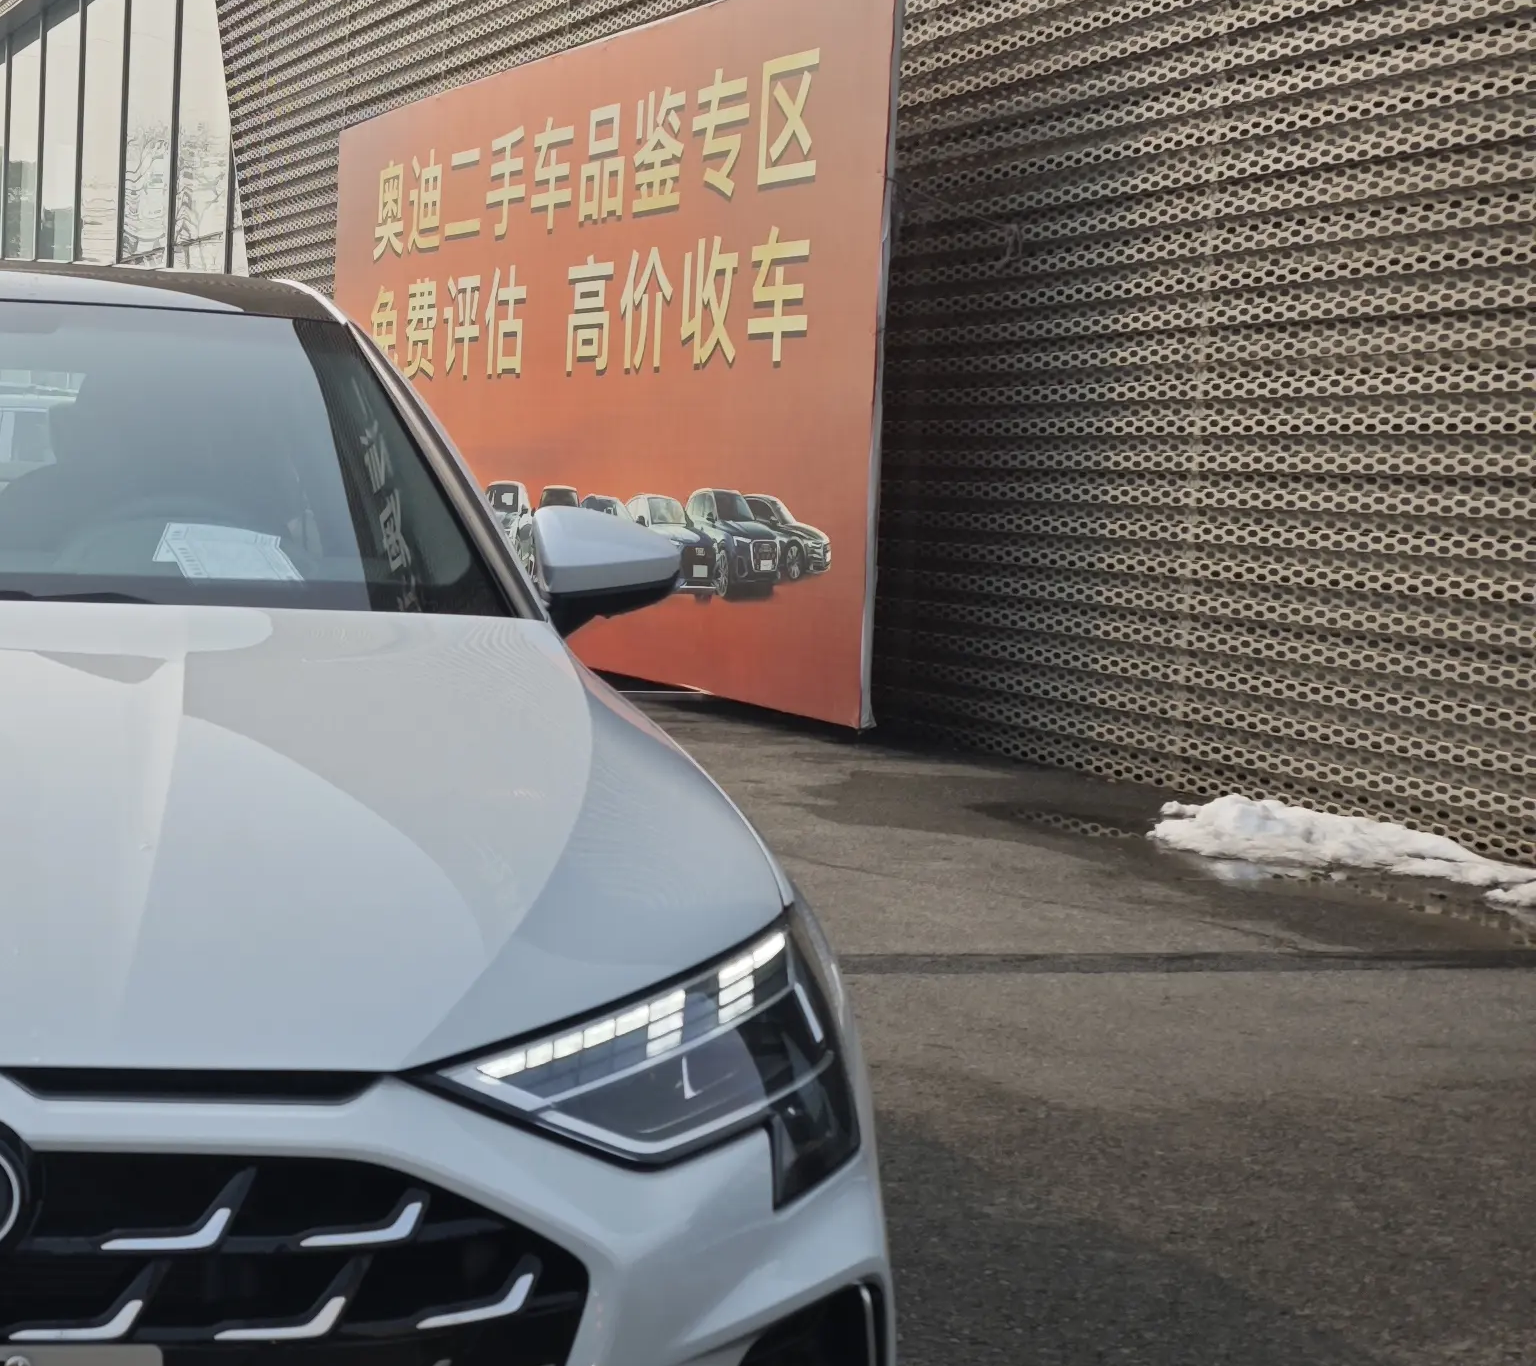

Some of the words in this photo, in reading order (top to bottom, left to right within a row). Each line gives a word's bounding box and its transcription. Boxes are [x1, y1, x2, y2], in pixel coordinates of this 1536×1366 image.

[373, 48, 820, 261] 奥迪二手车品鉴专区
[371, 265, 527, 380] 免费评估
[566, 226, 810, 374] 高价收车
